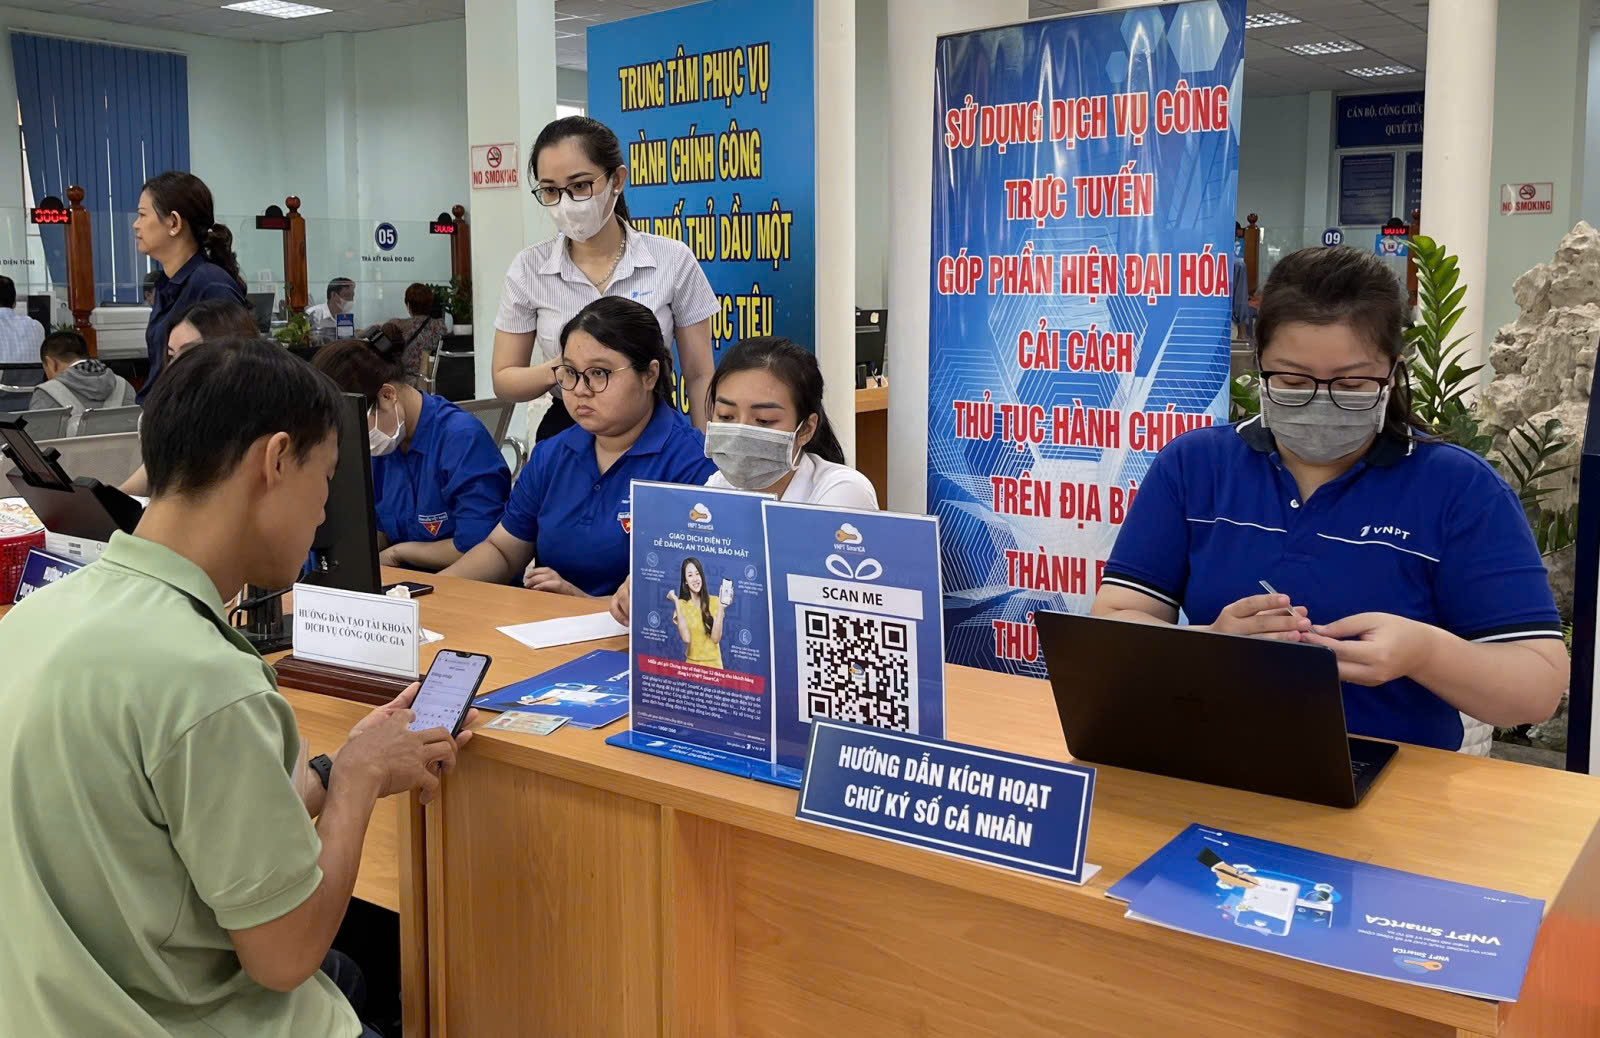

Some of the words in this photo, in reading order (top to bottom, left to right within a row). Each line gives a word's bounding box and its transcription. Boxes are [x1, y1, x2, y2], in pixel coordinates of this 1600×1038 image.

[618, 60, 665, 112] TRUNG
[666, 44, 699, 106] TÂM
[702, 45, 745, 108] PHỤC
[746, 41, 770, 104] VỤ
[945, 94, 978, 149] SỬ
[980, 101, 1043, 154] DỤNG
[1049, 95, 1108, 149] DỊCH
[1113, 92, 1148, 145] VỤ
[1156, 79, 1228, 135] CÔNG
[629, 129, 668, 187] HÀNH
[670, 123, 715, 185] CHÍNH
[718, 118, 761, 182] CÔNG
[473, 171, 483, 184] NO
[485, 169, 517, 184] SMOKING
[1004, 174, 1067, 228] TRỰC
[1073, 160, 1153, 219] TUYẾN
[1515, 201, 1551, 211] SMOKING
[378, 229, 394, 244] 05
[685, 196, 715, 262] THỦ
[720, 193, 752, 262] DẦU
[756, 198, 793, 271] MỘT
[1325, 232, 1340, 244] 09
[938, 248, 983, 295] GÓP
[988, 240, 1053, 296] PHẦN
[1060, 245, 1118, 304] HIỆN
[1124, 253, 1171, 306] ĐẠI
[1179, 244, 1229, 297] HÓA
[711, 293, 733, 349] ỤC
[736, 282, 773, 341] TIÊU
[1017, 317, 1059, 371] CẢI
[1066, 324, 1133, 373] CÁCH
[953, 389, 994, 442] THỦ
[1000, 402, 1045, 452] TỤC
[1052, 398, 1120, 449] HÀNH
[990, 471, 1051, 518] TRÊN
[1059, 482, 1102, 529] ĐỊA
[669, 532, 685, 540] GIAO
[687, 534, 703, 543] DỊCH
[704, 536, 720, 545] ĐIỆN
[697, 543, 717, 554] TOÀN,
[734, 548, 749, 559] MẬT
[1373, 525, 1410, 540] VNPT
[1005, 545, 1086, 595] THÀNH
[823, 586, 859, 603] SCAN
[862, 592, 883, 606] ME
[305, 622, 324, 633] DỊCH
[326, 625, 338, 637] VỤ
[339, 626, 362, 639] CÔNG
[390, 636, 405, 646] GIA
[347, 617, 364, 628] TẠO
[366, 618, 380, 630] TÀI
[993, 611, 1039, 663] THỦ
[839, 744, 900, 779] HƯỚNG
[904, 752, 944, 787] DẪN
[947, 764, 994, 798] KÍCH
[999, 777, 1052, 813] HOẠT
[844, 784, 884, 813] CHỮ
[884, 791, 911, 820] KÝ
[914, 794, 943, 827] SỐ
[944, 804, 970, 834] CÁ
[974, 812, 1033, 848] NHÂN
[1365, 914, 1443, 937] SmartCA
[1445, 931, 1501, 946] VNPT
[1392, 947, 1427, 958] SmartCA
[1428, 954, 1449, 962] VNPT
